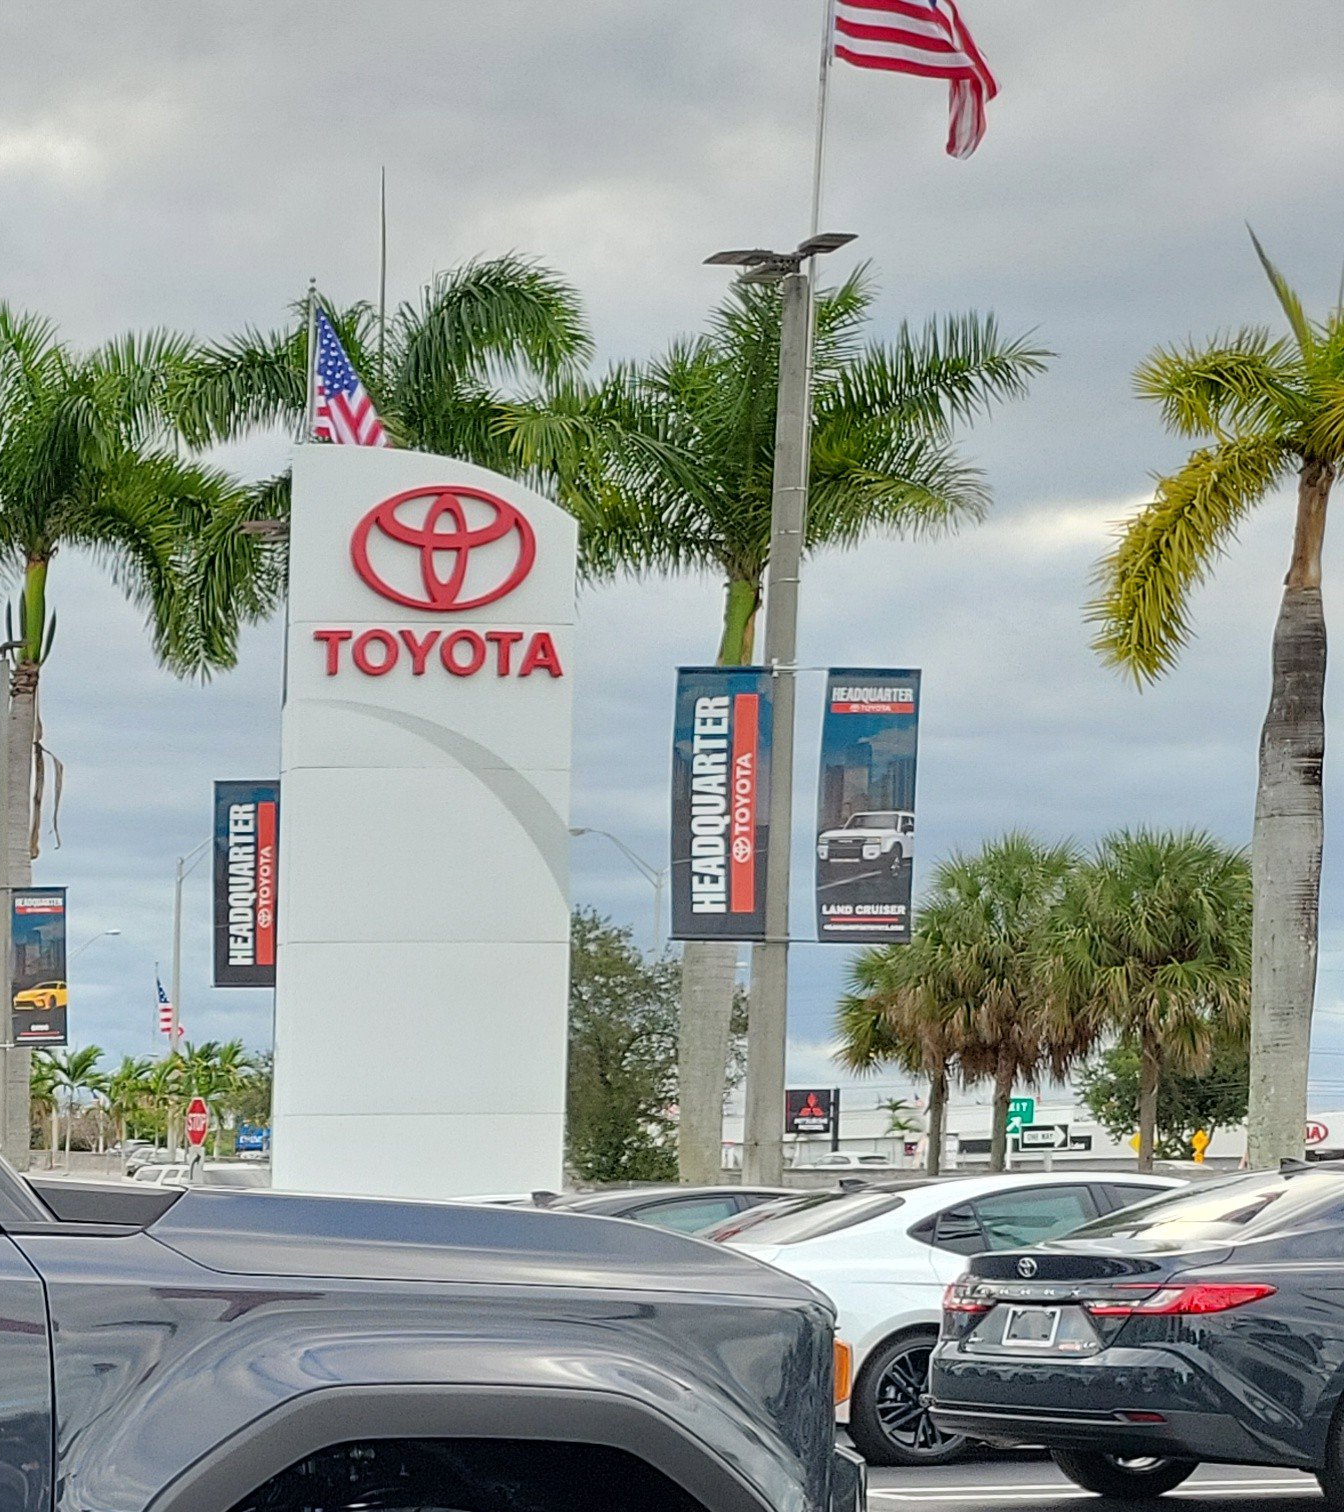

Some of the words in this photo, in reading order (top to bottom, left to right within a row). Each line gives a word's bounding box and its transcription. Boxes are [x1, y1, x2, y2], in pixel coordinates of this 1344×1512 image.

[313, 629, 563, 678] TOYOTA
[832, 687, 913, 703] HEADQUARTER
[861, 704, 892, 712] TOYOTA
[691, 696, 730, 914] HEADQUARTER
[735, 752, 753, 835] TOYOTA
[228, 803, 257, 966] HEADQUARTER
[259, 846, 272, 910] TOYOTA
[822, 904, 853, 915] LAND
[855, 904, 906, 915] CRUISER
[188, 1113, 206, 1131] STOP
[1306, 1127, 1322, 1140] IA
